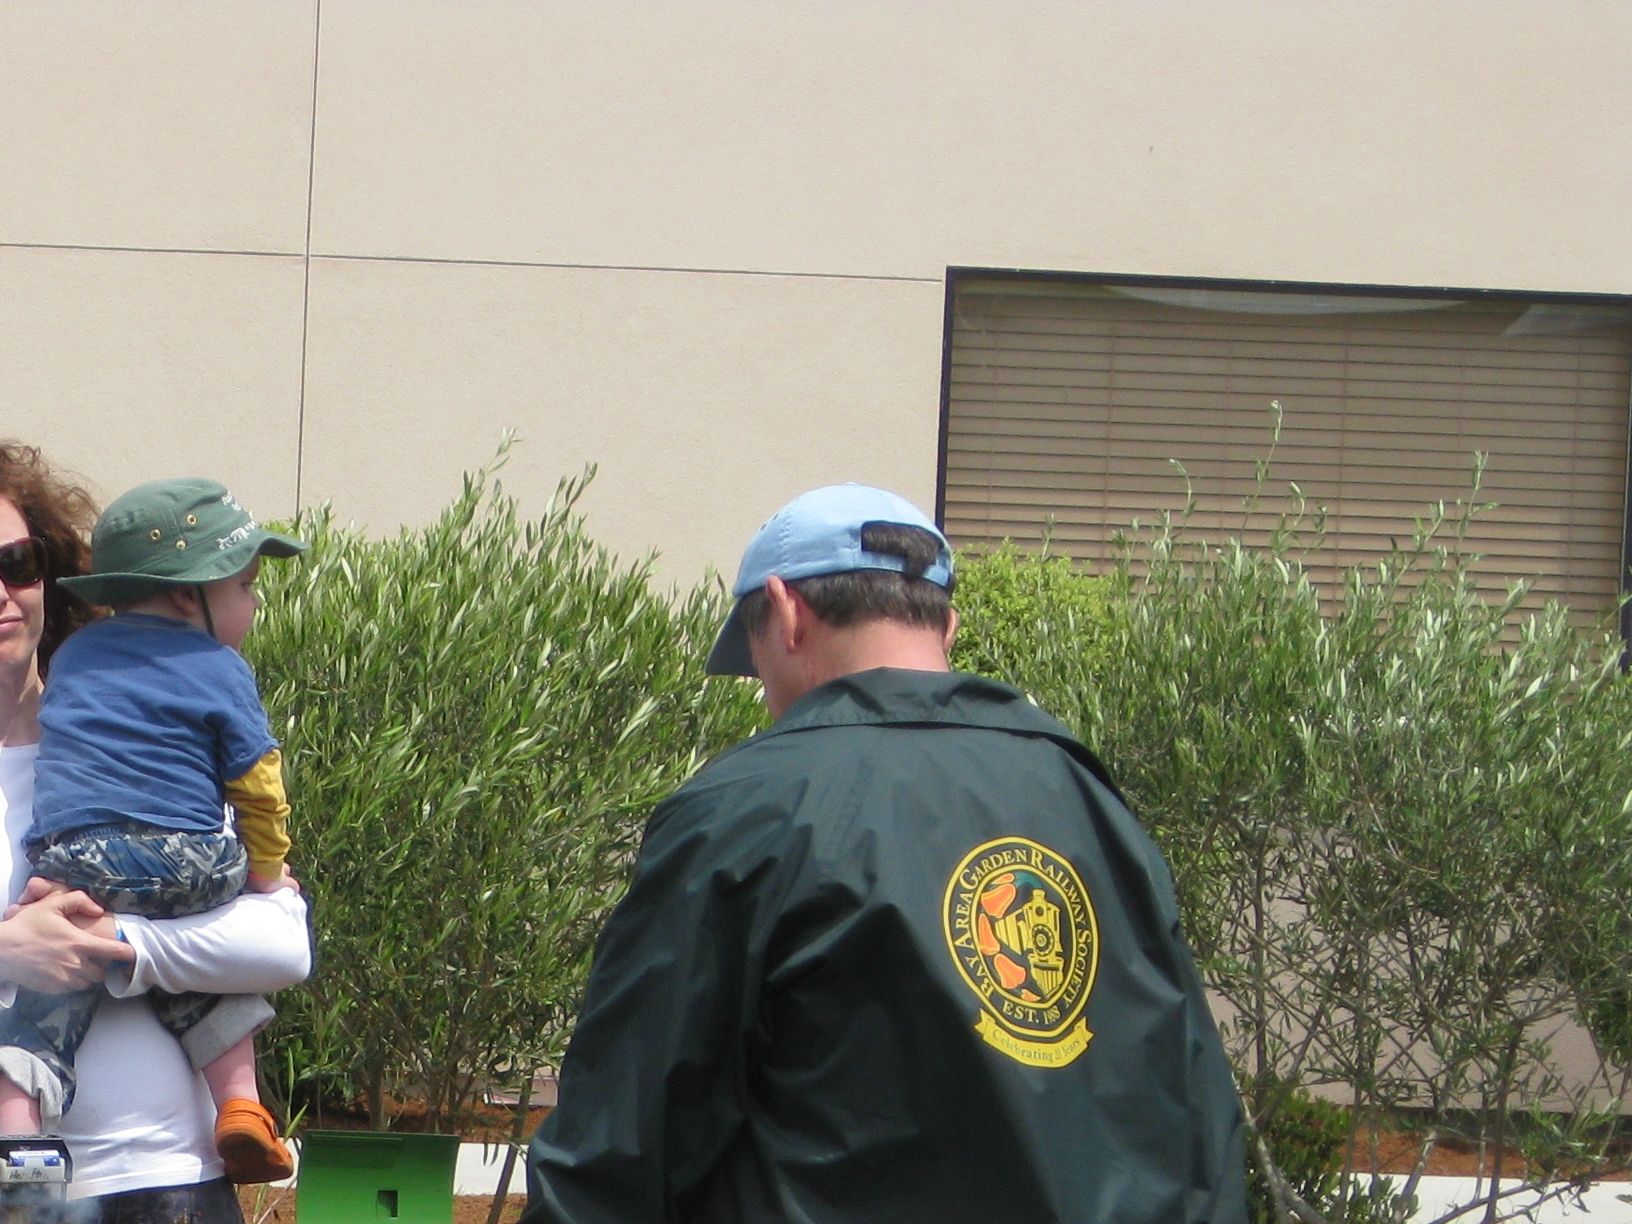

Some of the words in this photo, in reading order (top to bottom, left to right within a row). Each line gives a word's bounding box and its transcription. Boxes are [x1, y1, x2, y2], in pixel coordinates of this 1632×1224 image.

[959, 848, 1028, 890] GARDEN
[1031, 847, 1087, 925] RAILWAY
[954, 887, 976, 950] AREA
[965, 955, 997, 999] BAY
[1063, 928, 1091, 1008] SOCIETY
[1002, 999, 1040, 1023] EST.
[992, 1029, 1054, 1062] Celebrating
